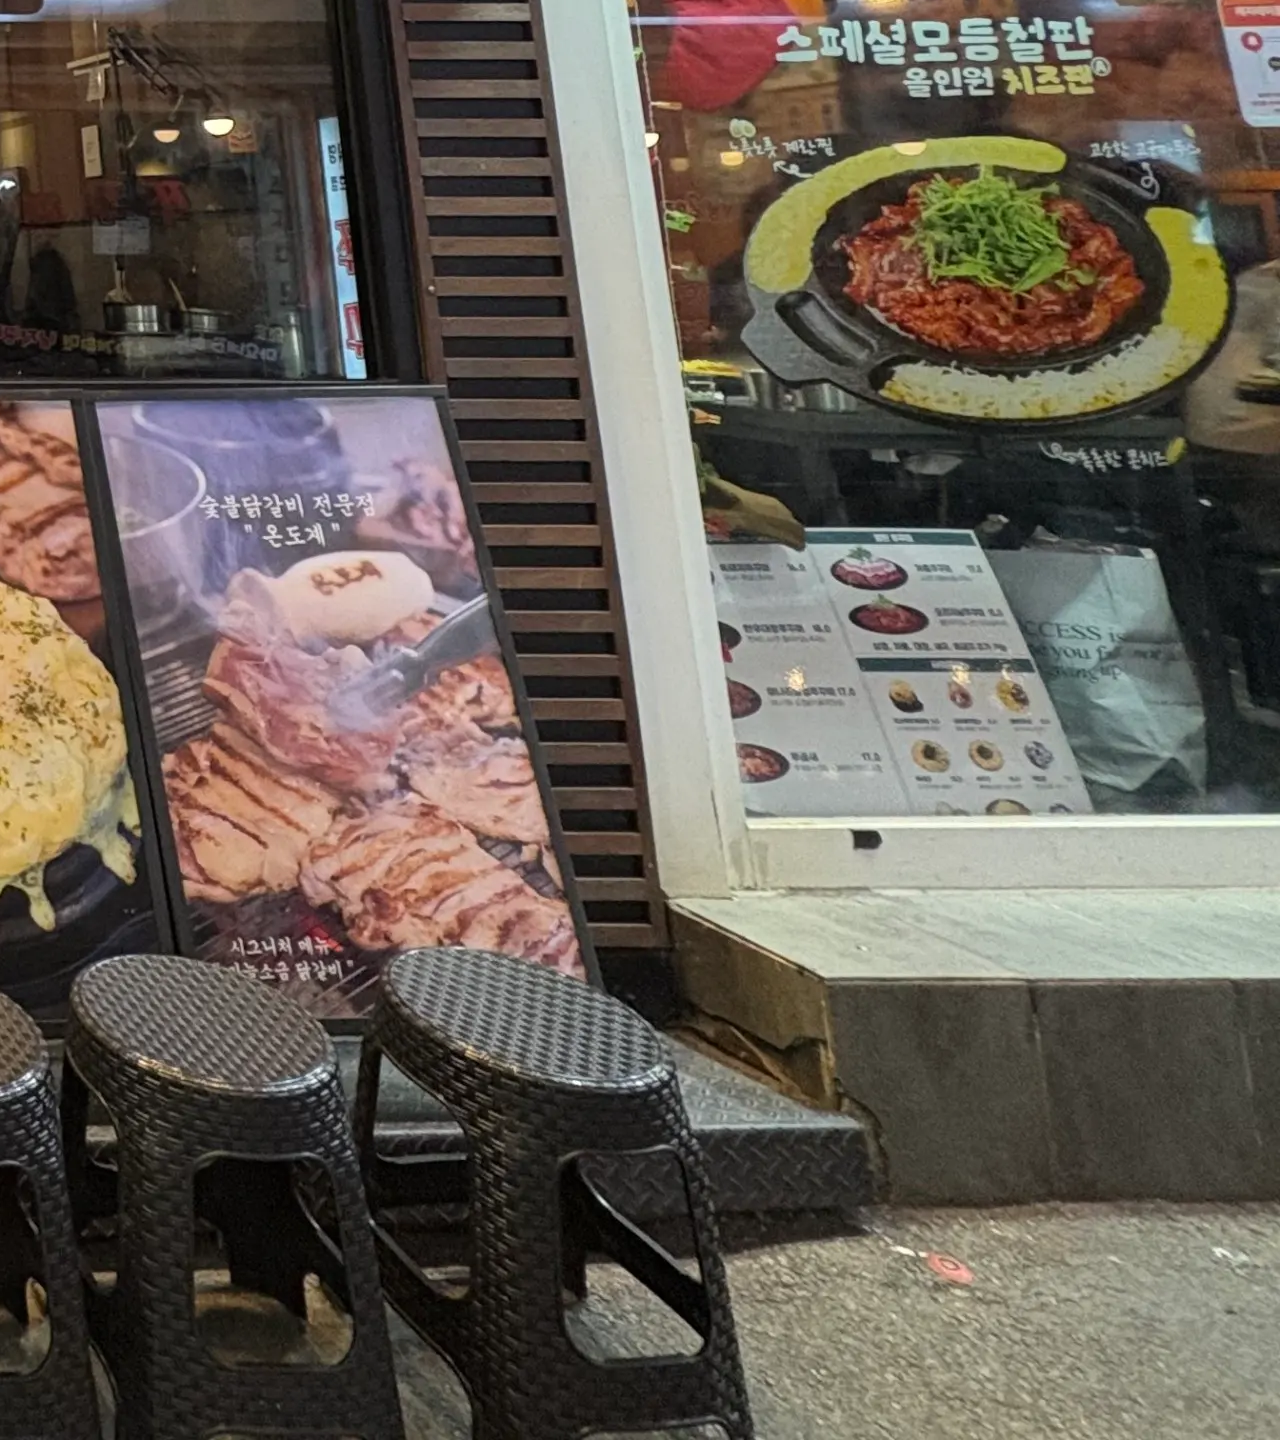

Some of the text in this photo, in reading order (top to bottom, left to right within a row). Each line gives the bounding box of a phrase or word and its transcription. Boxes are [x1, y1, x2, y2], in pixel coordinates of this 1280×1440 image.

[903, 67, 995, 98] 올인원
[1002, 64, 1095, 96] 치즈팬
[198, 493, 376, 519] 숯불닭갈비 전문점
[262, 523, 326, 548] 온도계
[231, 936, 329, 957] 시그니처 메뉴
[295, 960, 343, 981] 닭갈비
